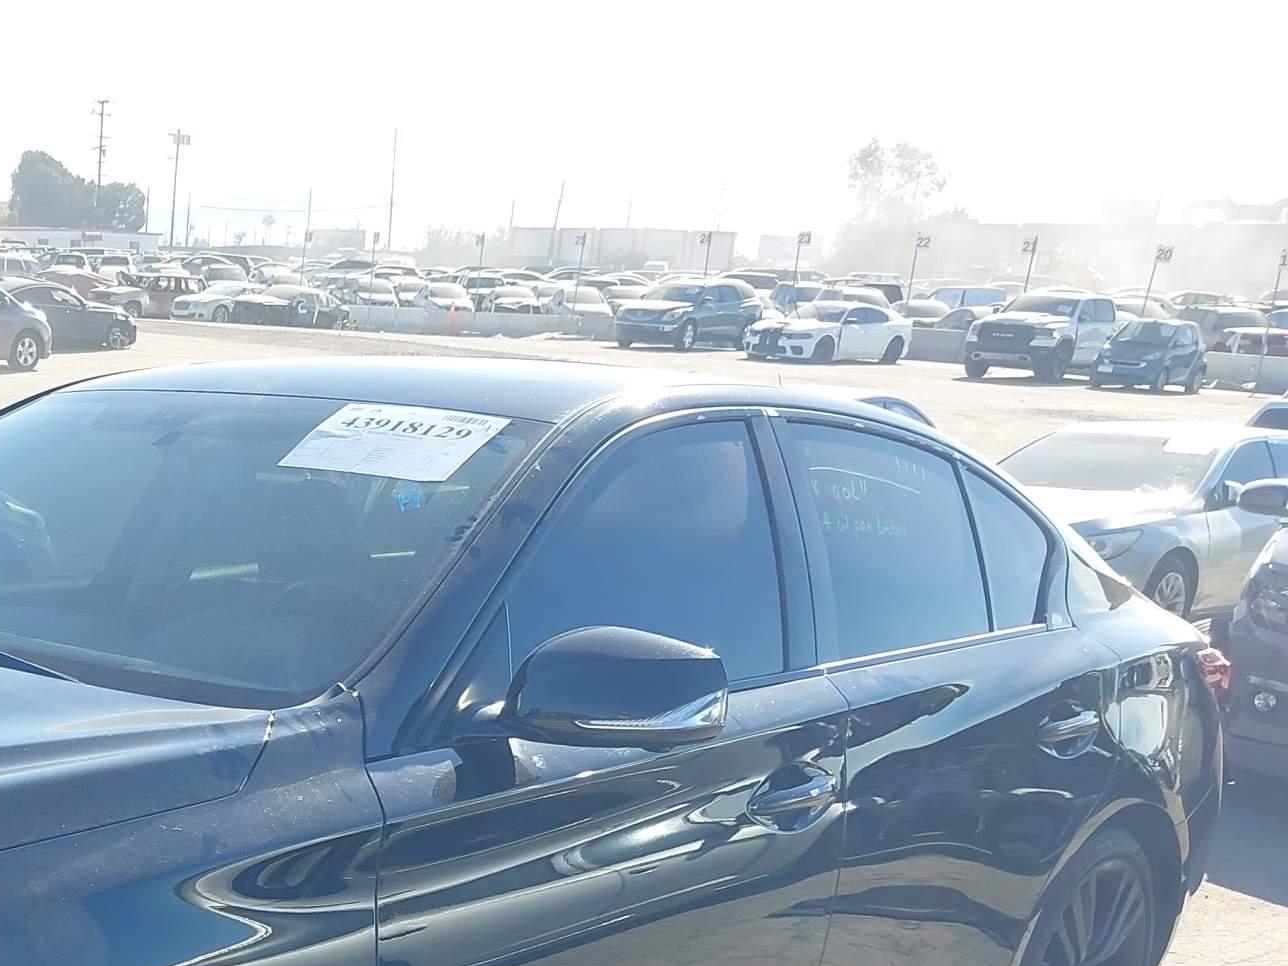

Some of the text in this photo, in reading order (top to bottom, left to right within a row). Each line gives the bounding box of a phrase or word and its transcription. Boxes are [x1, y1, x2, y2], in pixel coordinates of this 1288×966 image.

[798, 232, 811, 244] 23
[916, 236, 930, 248] 22
[1155, 247, 1173, 261] 20
[341, 416, 473, 440] 43918129
